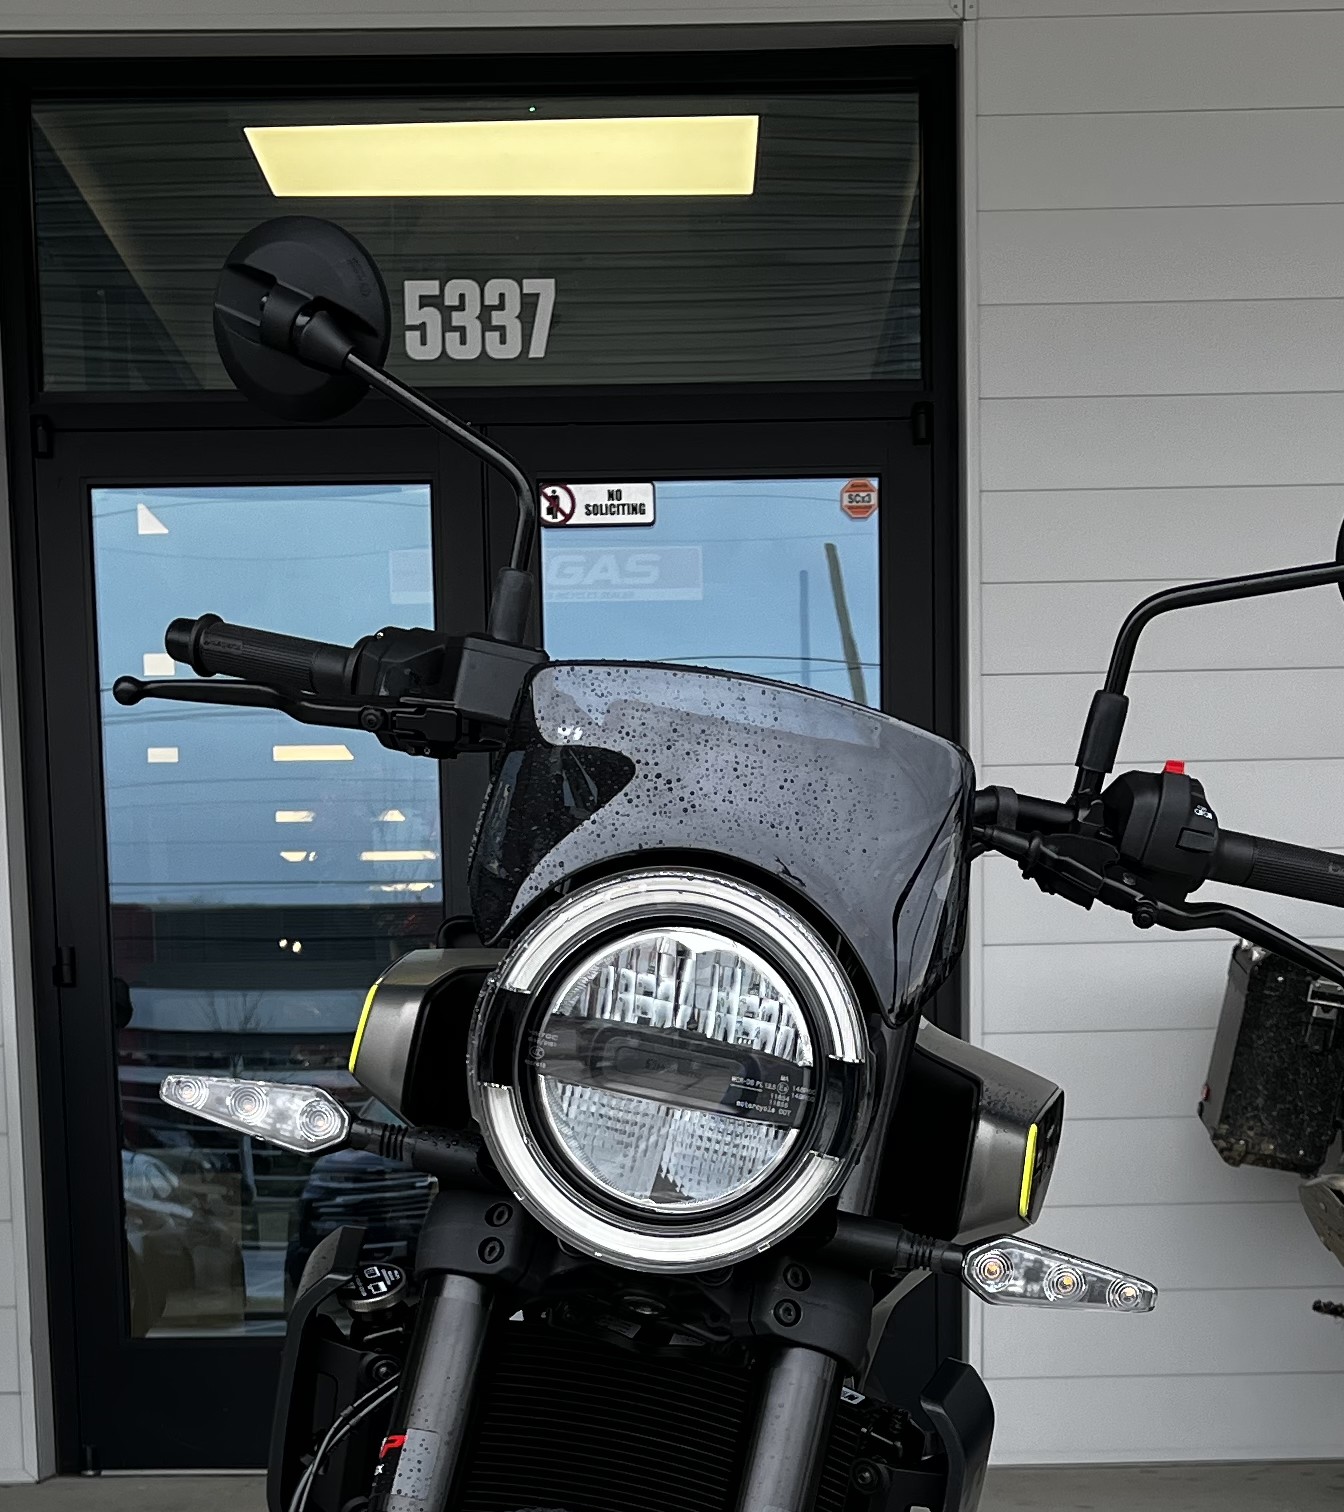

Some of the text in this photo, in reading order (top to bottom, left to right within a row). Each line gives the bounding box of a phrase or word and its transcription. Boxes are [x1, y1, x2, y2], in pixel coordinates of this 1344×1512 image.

[403, 279, 556, 360] 5337
[606, 488, 623, 501] NO
[584, 502, 647, 516] SOLICITING
